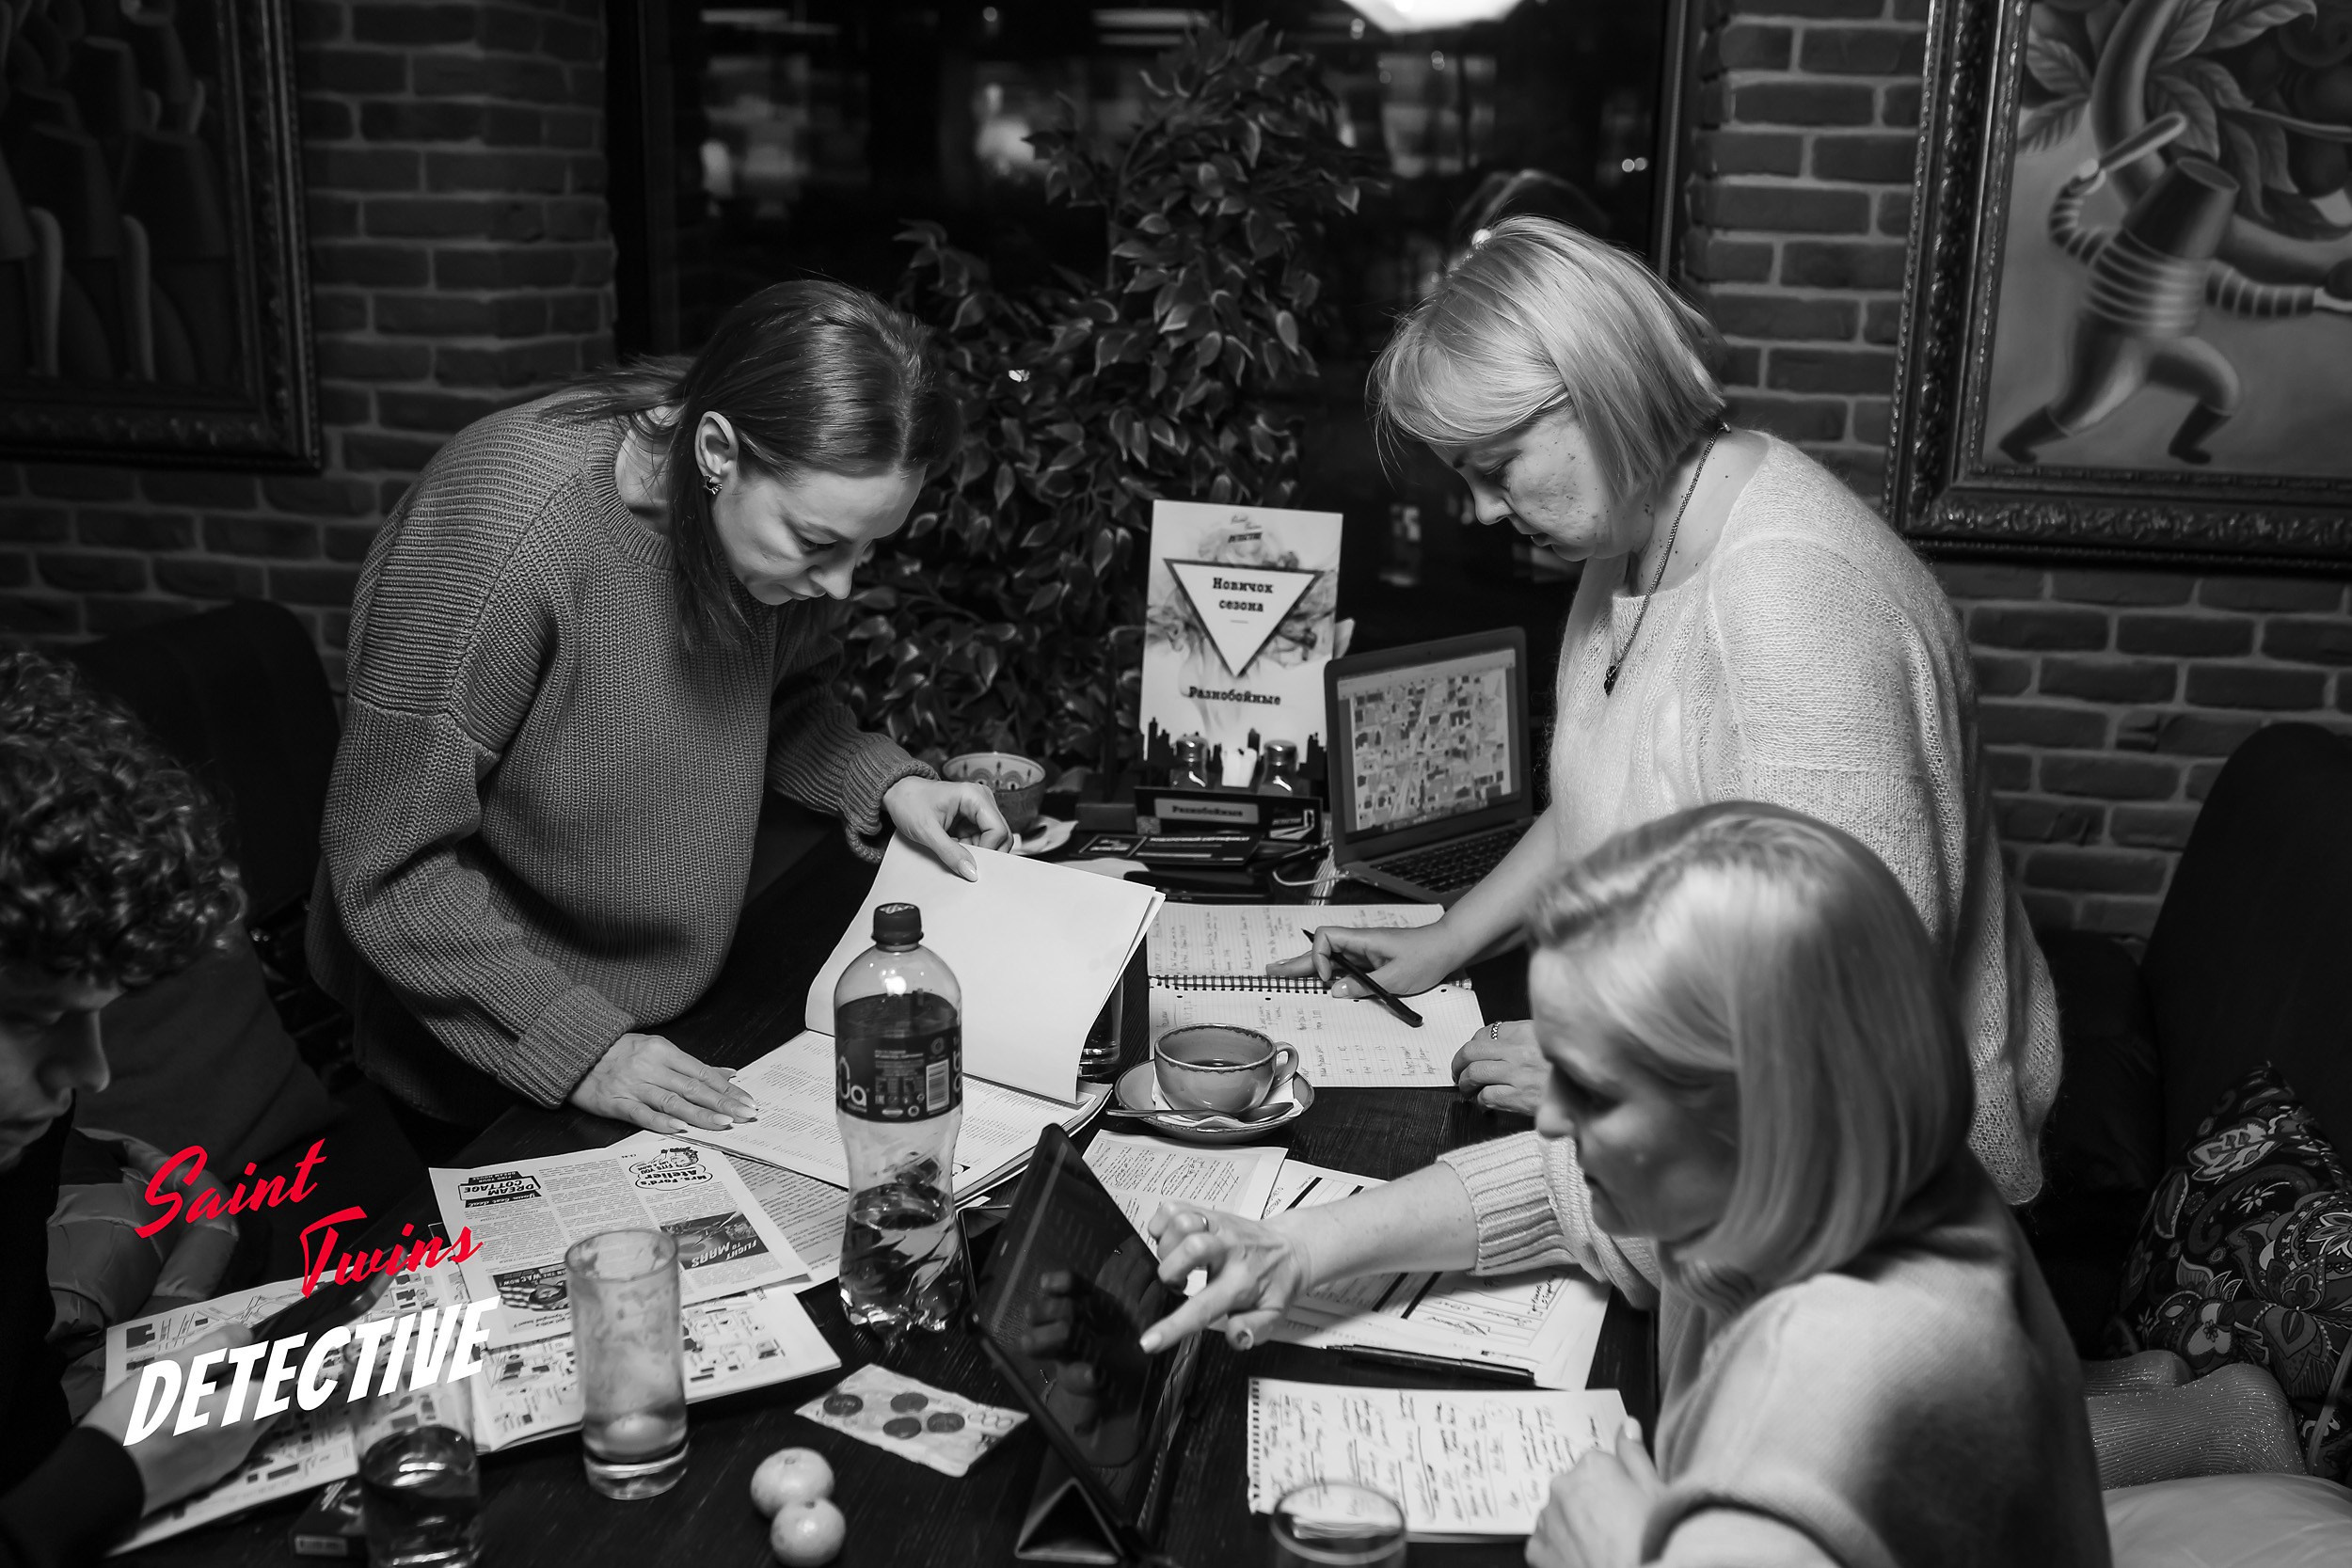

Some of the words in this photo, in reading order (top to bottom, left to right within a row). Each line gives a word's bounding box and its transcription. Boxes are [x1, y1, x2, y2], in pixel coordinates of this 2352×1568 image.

[1213, 577, 1274, 594] Новичок
[1218, 599, 1264, 612] сезона
[1189, 686, 1281, 705] Разнобойные
[644, 1169, 697, 1180] Atelier
[464, 1180, 523, 1193] COTTAGE
[640, 1178, 678, 1186] Ford's
[487, 1183, 534, 1196] DREAM
[691, 1242, 730, 1268] MARS
[725, 1239, 757, 1260] FLIGHT
